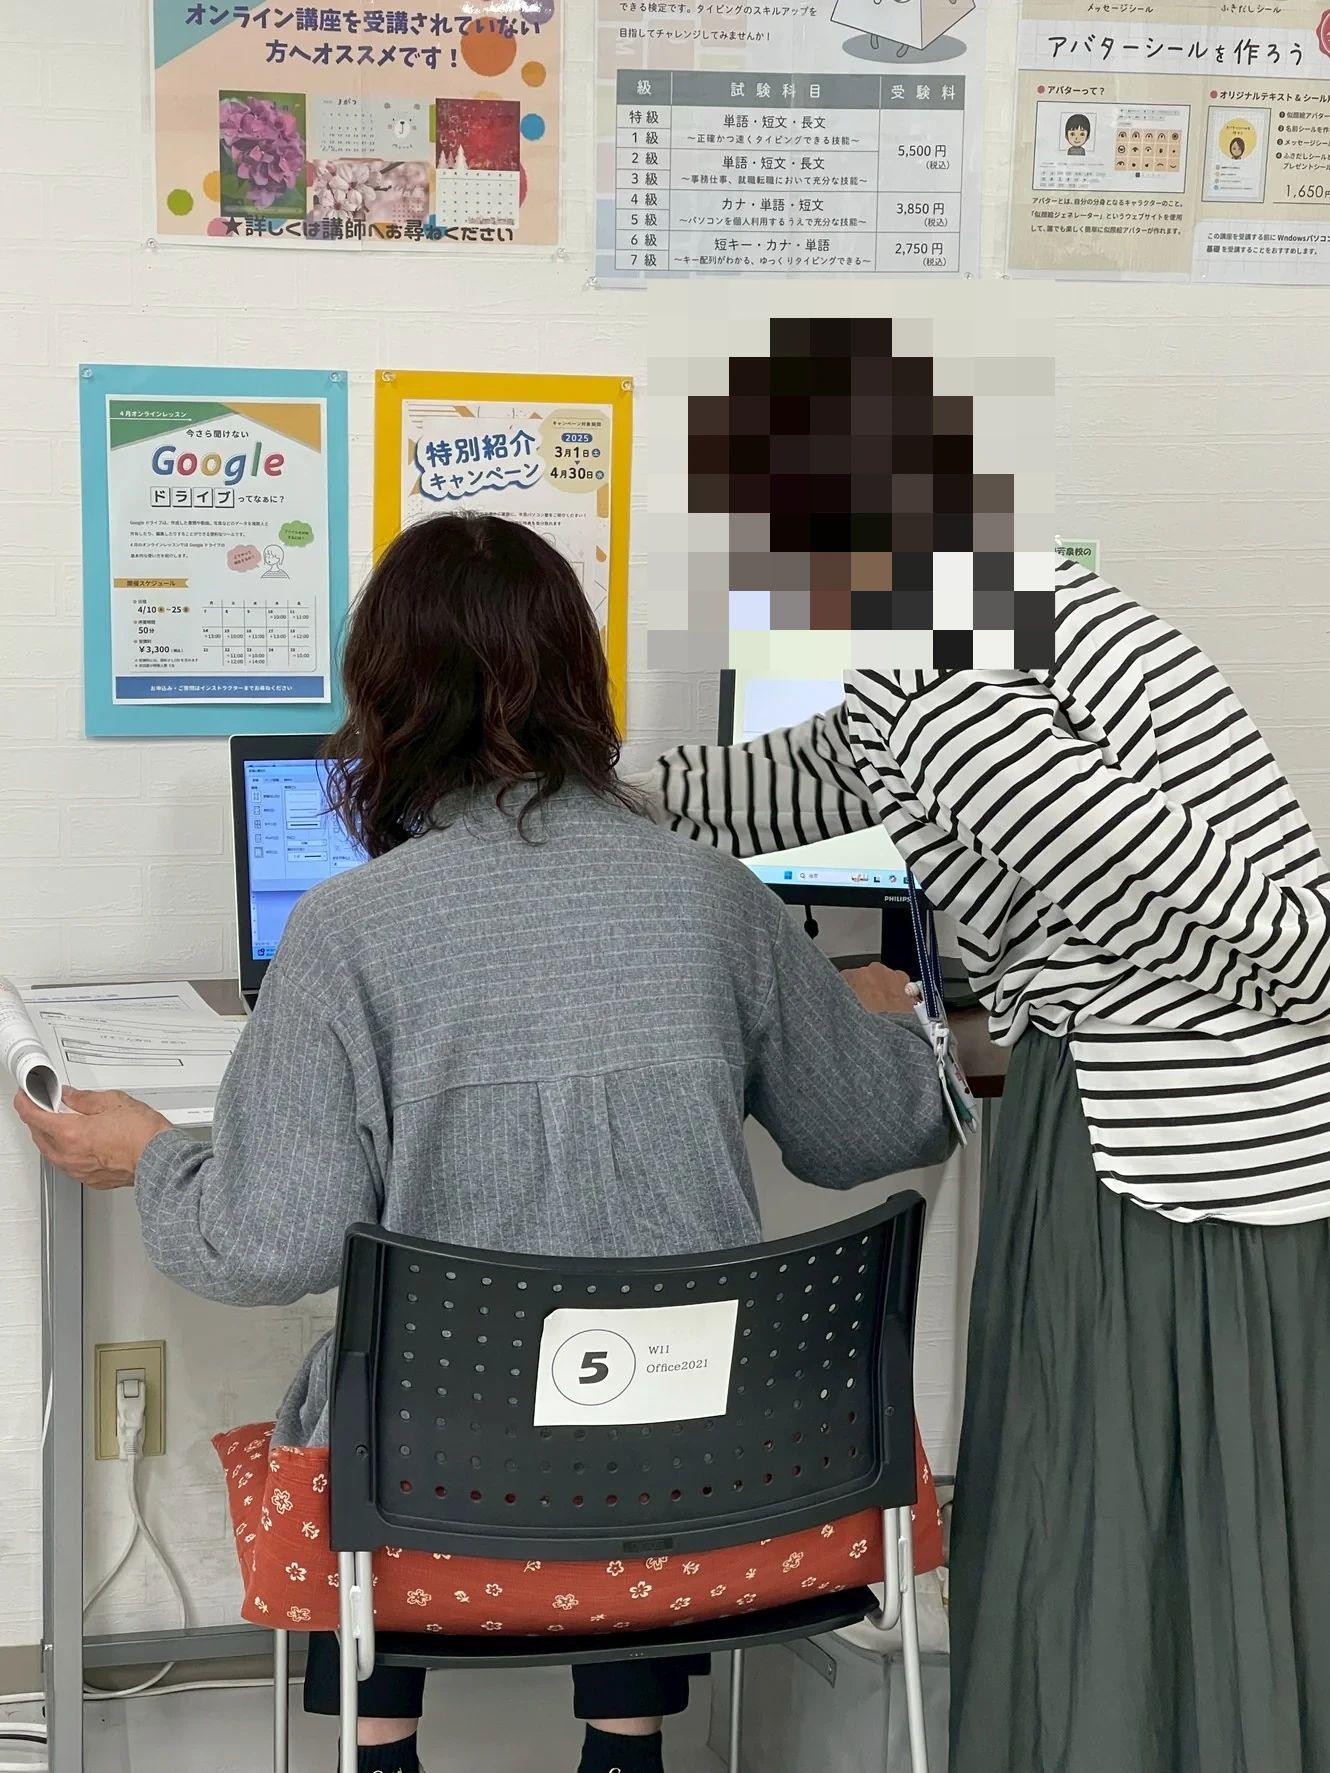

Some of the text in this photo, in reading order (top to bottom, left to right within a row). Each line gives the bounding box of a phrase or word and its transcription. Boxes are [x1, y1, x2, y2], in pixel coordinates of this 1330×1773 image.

[619, 2, 817, 17] できる検定です。タイピングのスキルアップを
[1087, 3, 1153, 13] メッセージシール
[1220, 4, 1282, 14] ふきだしシール
[184, 4, 541, 39] オンライン講座を受講されていない
[1048, 34, 1303, 66] アバターシールを作ろう
[637, 80, 652, 95] 級
[629, 110, 659, 124] 特級
[565, 434, 589, 442] 2025
[426, 430, 536, 467] 特別紹介
[151, 441, 285, 486] Google
[430, 463, 539, 490] キャンペーン
[153, 489, 233, 506] ドライブ
[884, 895, 911, 903] PHILIPS
[578, 1351, 609, 1384] 5
[646, 1359, 708, 1374] Office2021
